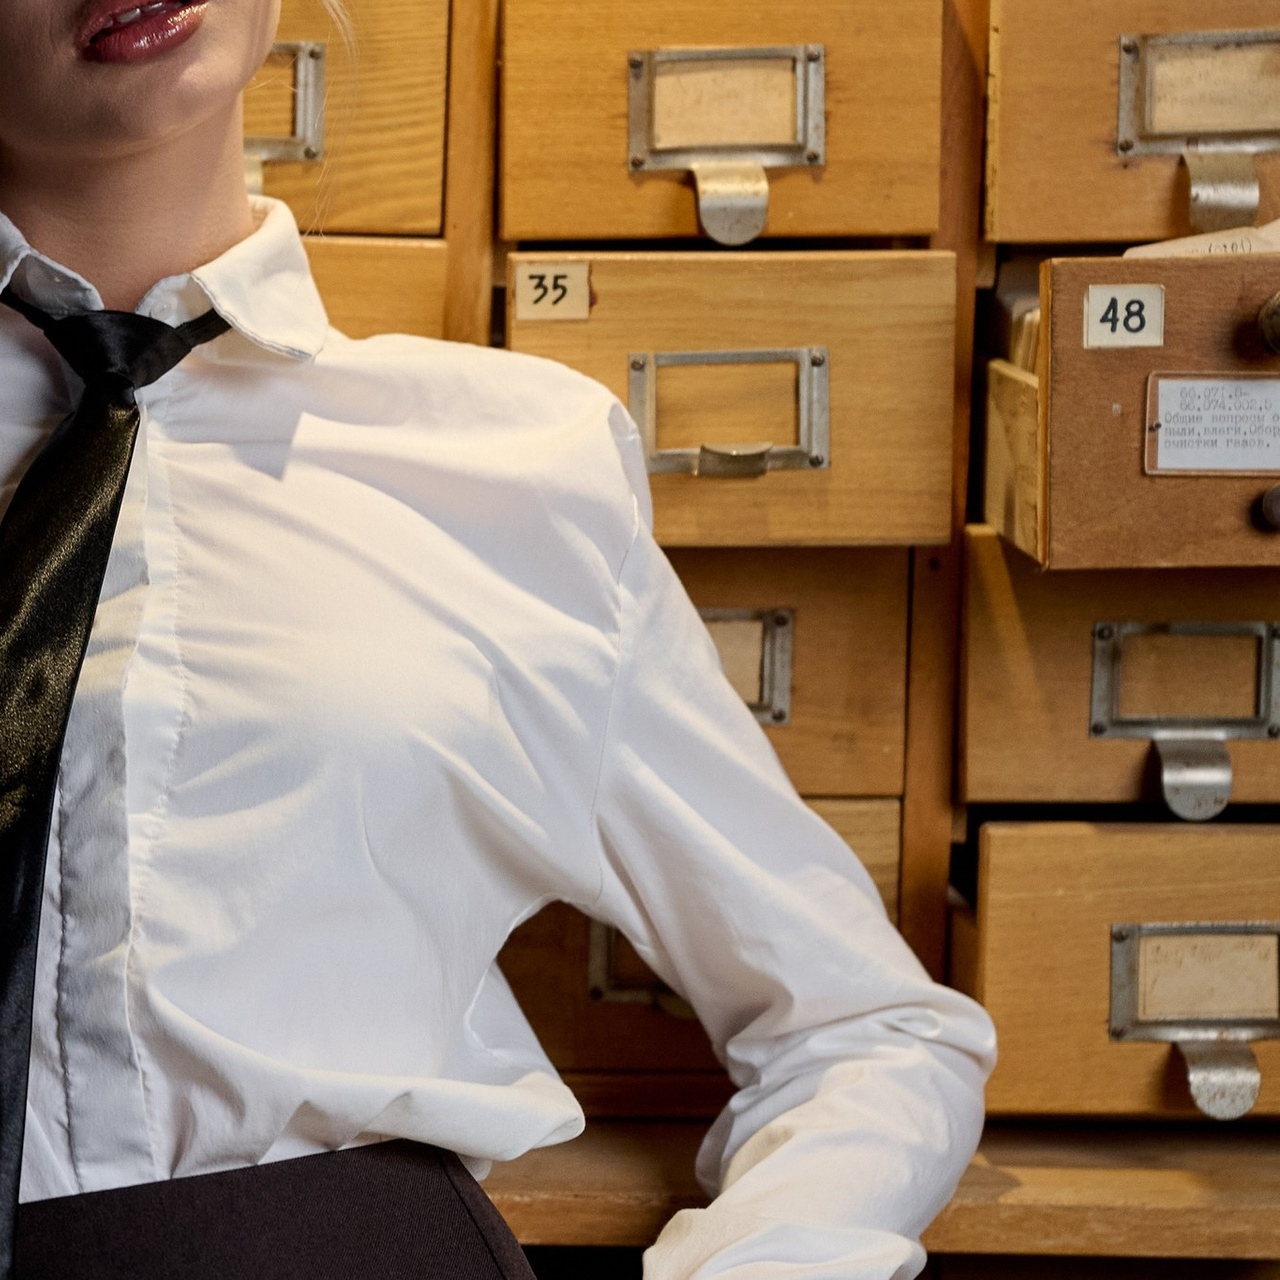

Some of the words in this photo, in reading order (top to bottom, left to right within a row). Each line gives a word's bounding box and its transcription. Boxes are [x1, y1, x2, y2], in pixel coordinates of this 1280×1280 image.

[528, 274, 568, 306] 35
[1100, 296, 1146, 333] 48
[1164, 411, 1203, 426] Общие
[1164, 438, 1218, 449] очистки
